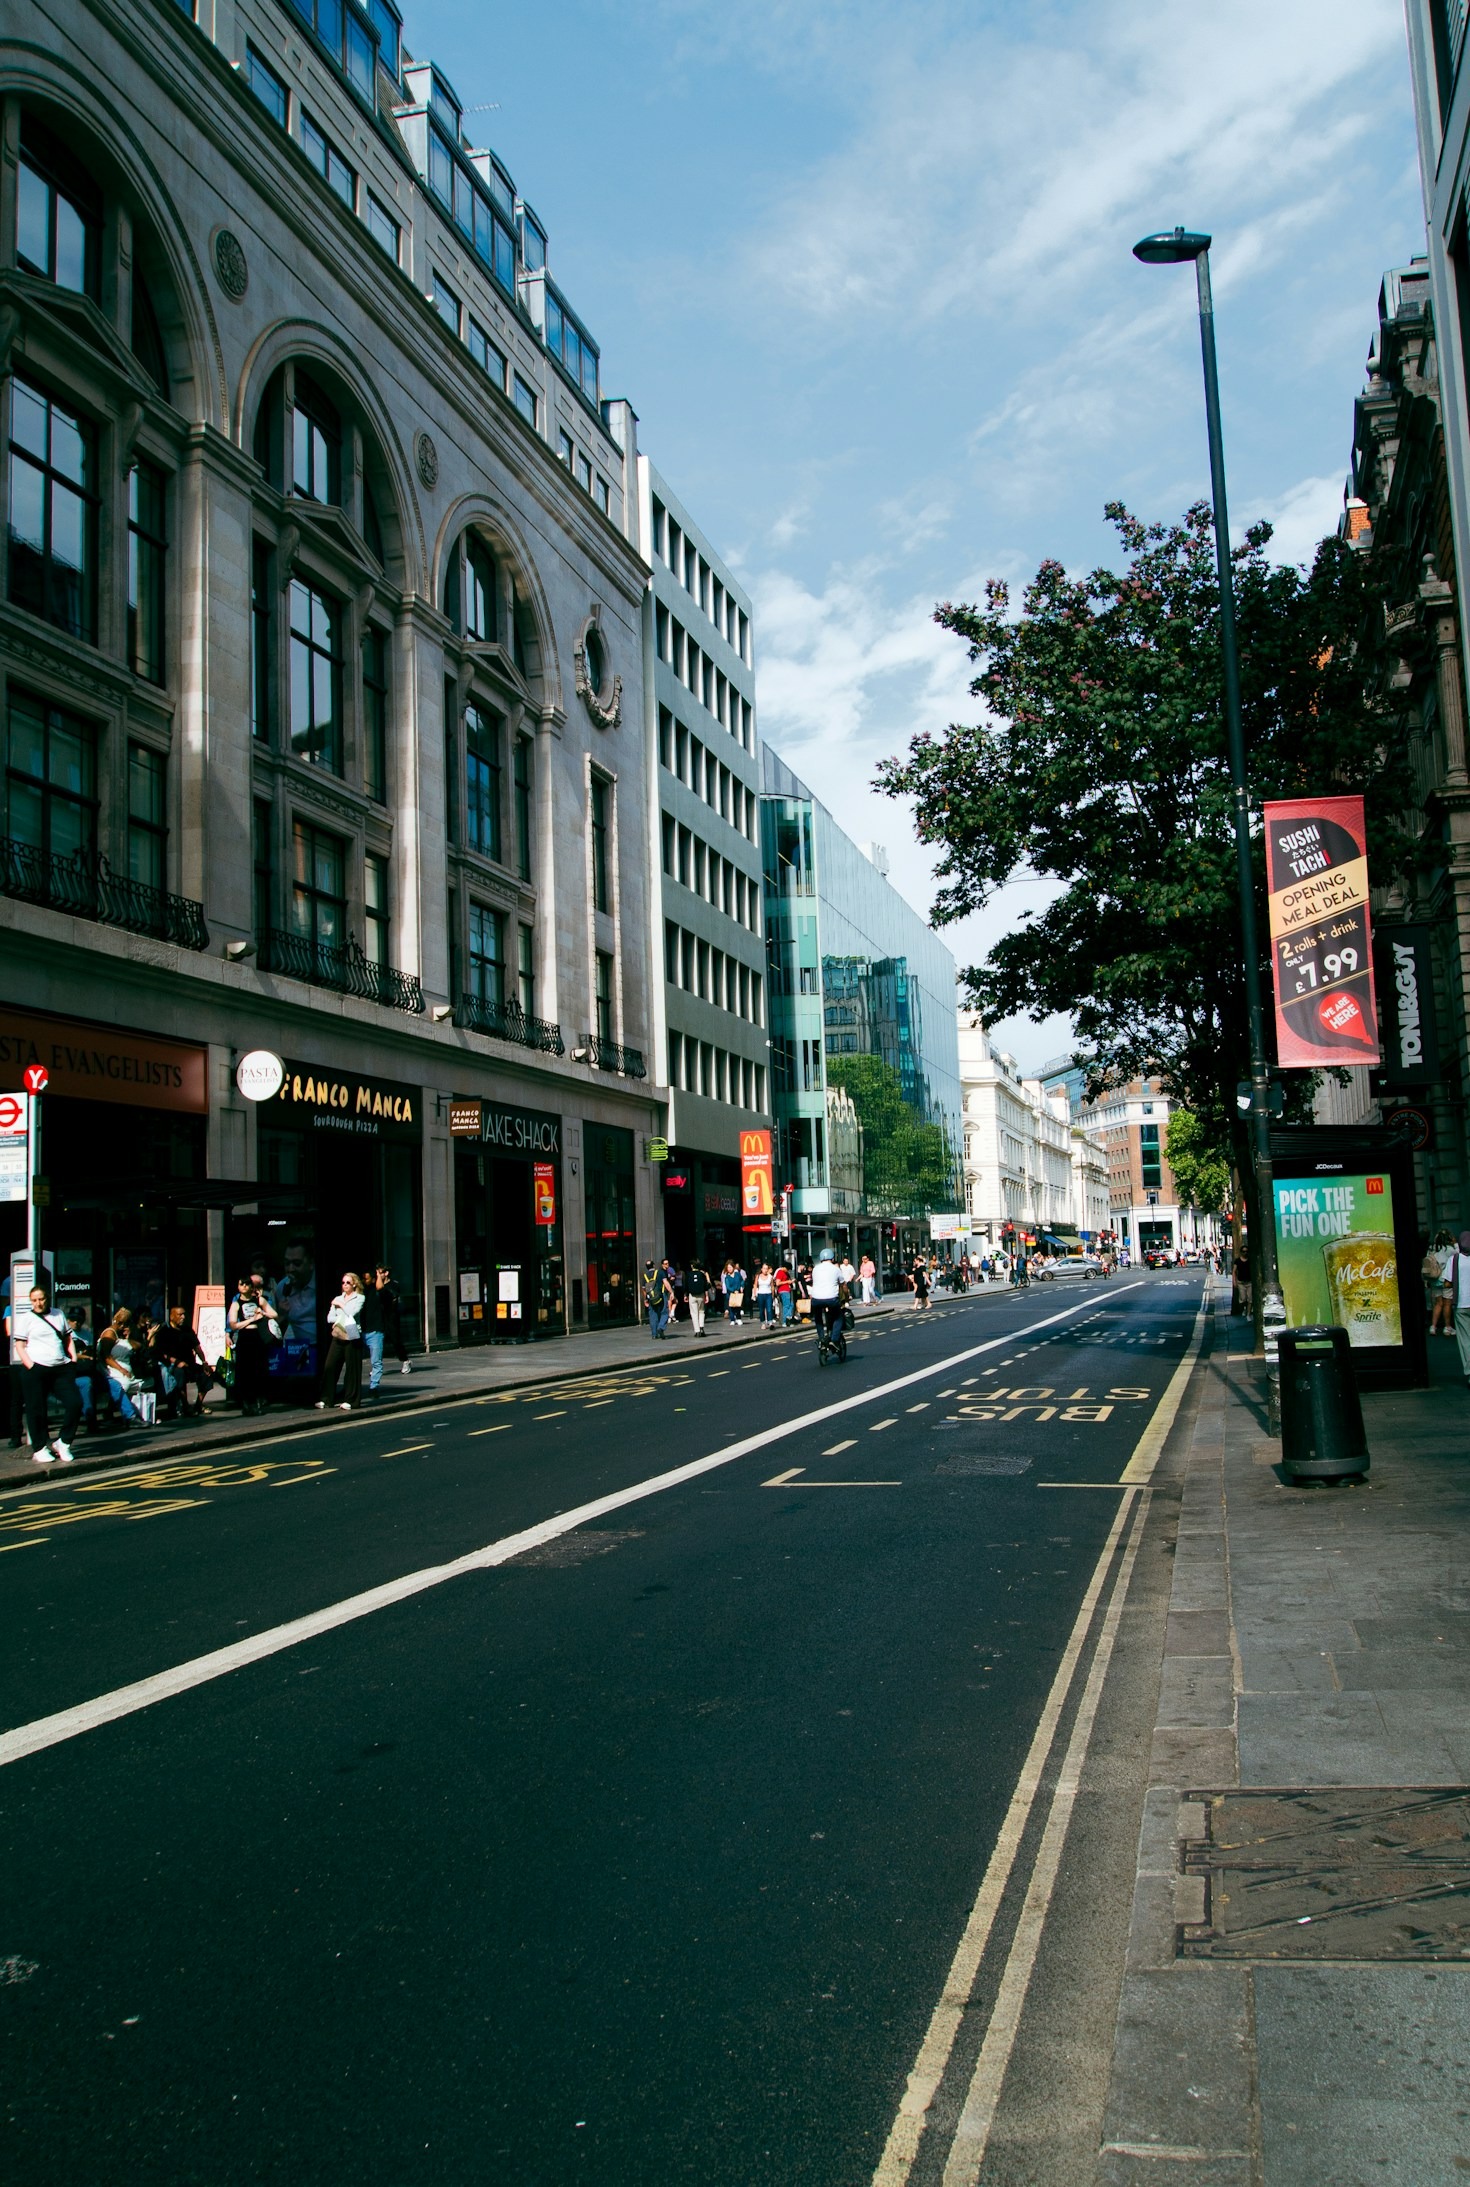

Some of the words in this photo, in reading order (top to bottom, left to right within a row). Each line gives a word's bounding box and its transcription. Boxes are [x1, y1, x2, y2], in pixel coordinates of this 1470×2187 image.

[1279, 824, 1321, 853] SUSHI
[1289, 849, 1331, 878] TACHI
[1282, 873, 1347, 907] OPENING
[1282, 902, 1322, 926] MEAL
[1322, 887, 1360, 909] DEAL
[1279, 941, 1294, 959] 2
[1294, 936, 1317, 953] rolls
[1330, 919, 1359, 938] drink
[1285, 955, 1304, 968] ONLY
[1321, 1007, 1336, 1019] WE
[1335, 996, 1350, 1010] ARE
[1329, 1003, 1360, 1030] HERE
[1392, 942, 1423, 1068] TONI&GUY
[0, 1036, 39, 1065] STA
[51, 1045, 183, 1088] EVANGELISTS
[240, 1067, 278, 1079] PASTA
[28, 1069, 43, 1089] Y
[356, 1085, 413, 1122] MANCA
[451, 1110, 479, 1118] FRANCO
[313, 1114, 354, 1131] SOURDOUGH
[355, 1119, 379, 1134] PIZZA
[452, 1117, 479, 1125] MANCA
[467, 1111, 513, 1146] HAKE
[515, 1118, 559, 1153] SHACK
[665, 1175, 687, 1189] sally
[785, 1184, 793, 1193] Z
[1278, 1188, 1320, 1214] PICK
[1322, 1186, 1355, 1212] THE
[1281, 1213, 1315, 1239] FUN
[1317, 1211, 1352, 1237] ONE
[58, 1282, 91, 1291] Camden
[1353, 1311, 1382, 1323] Sprite
[953, 1387, 1151, 1401] STOP
[945, 1405, 1115, 1422] BUS
[72, 1460, 325, 1492] BUS
